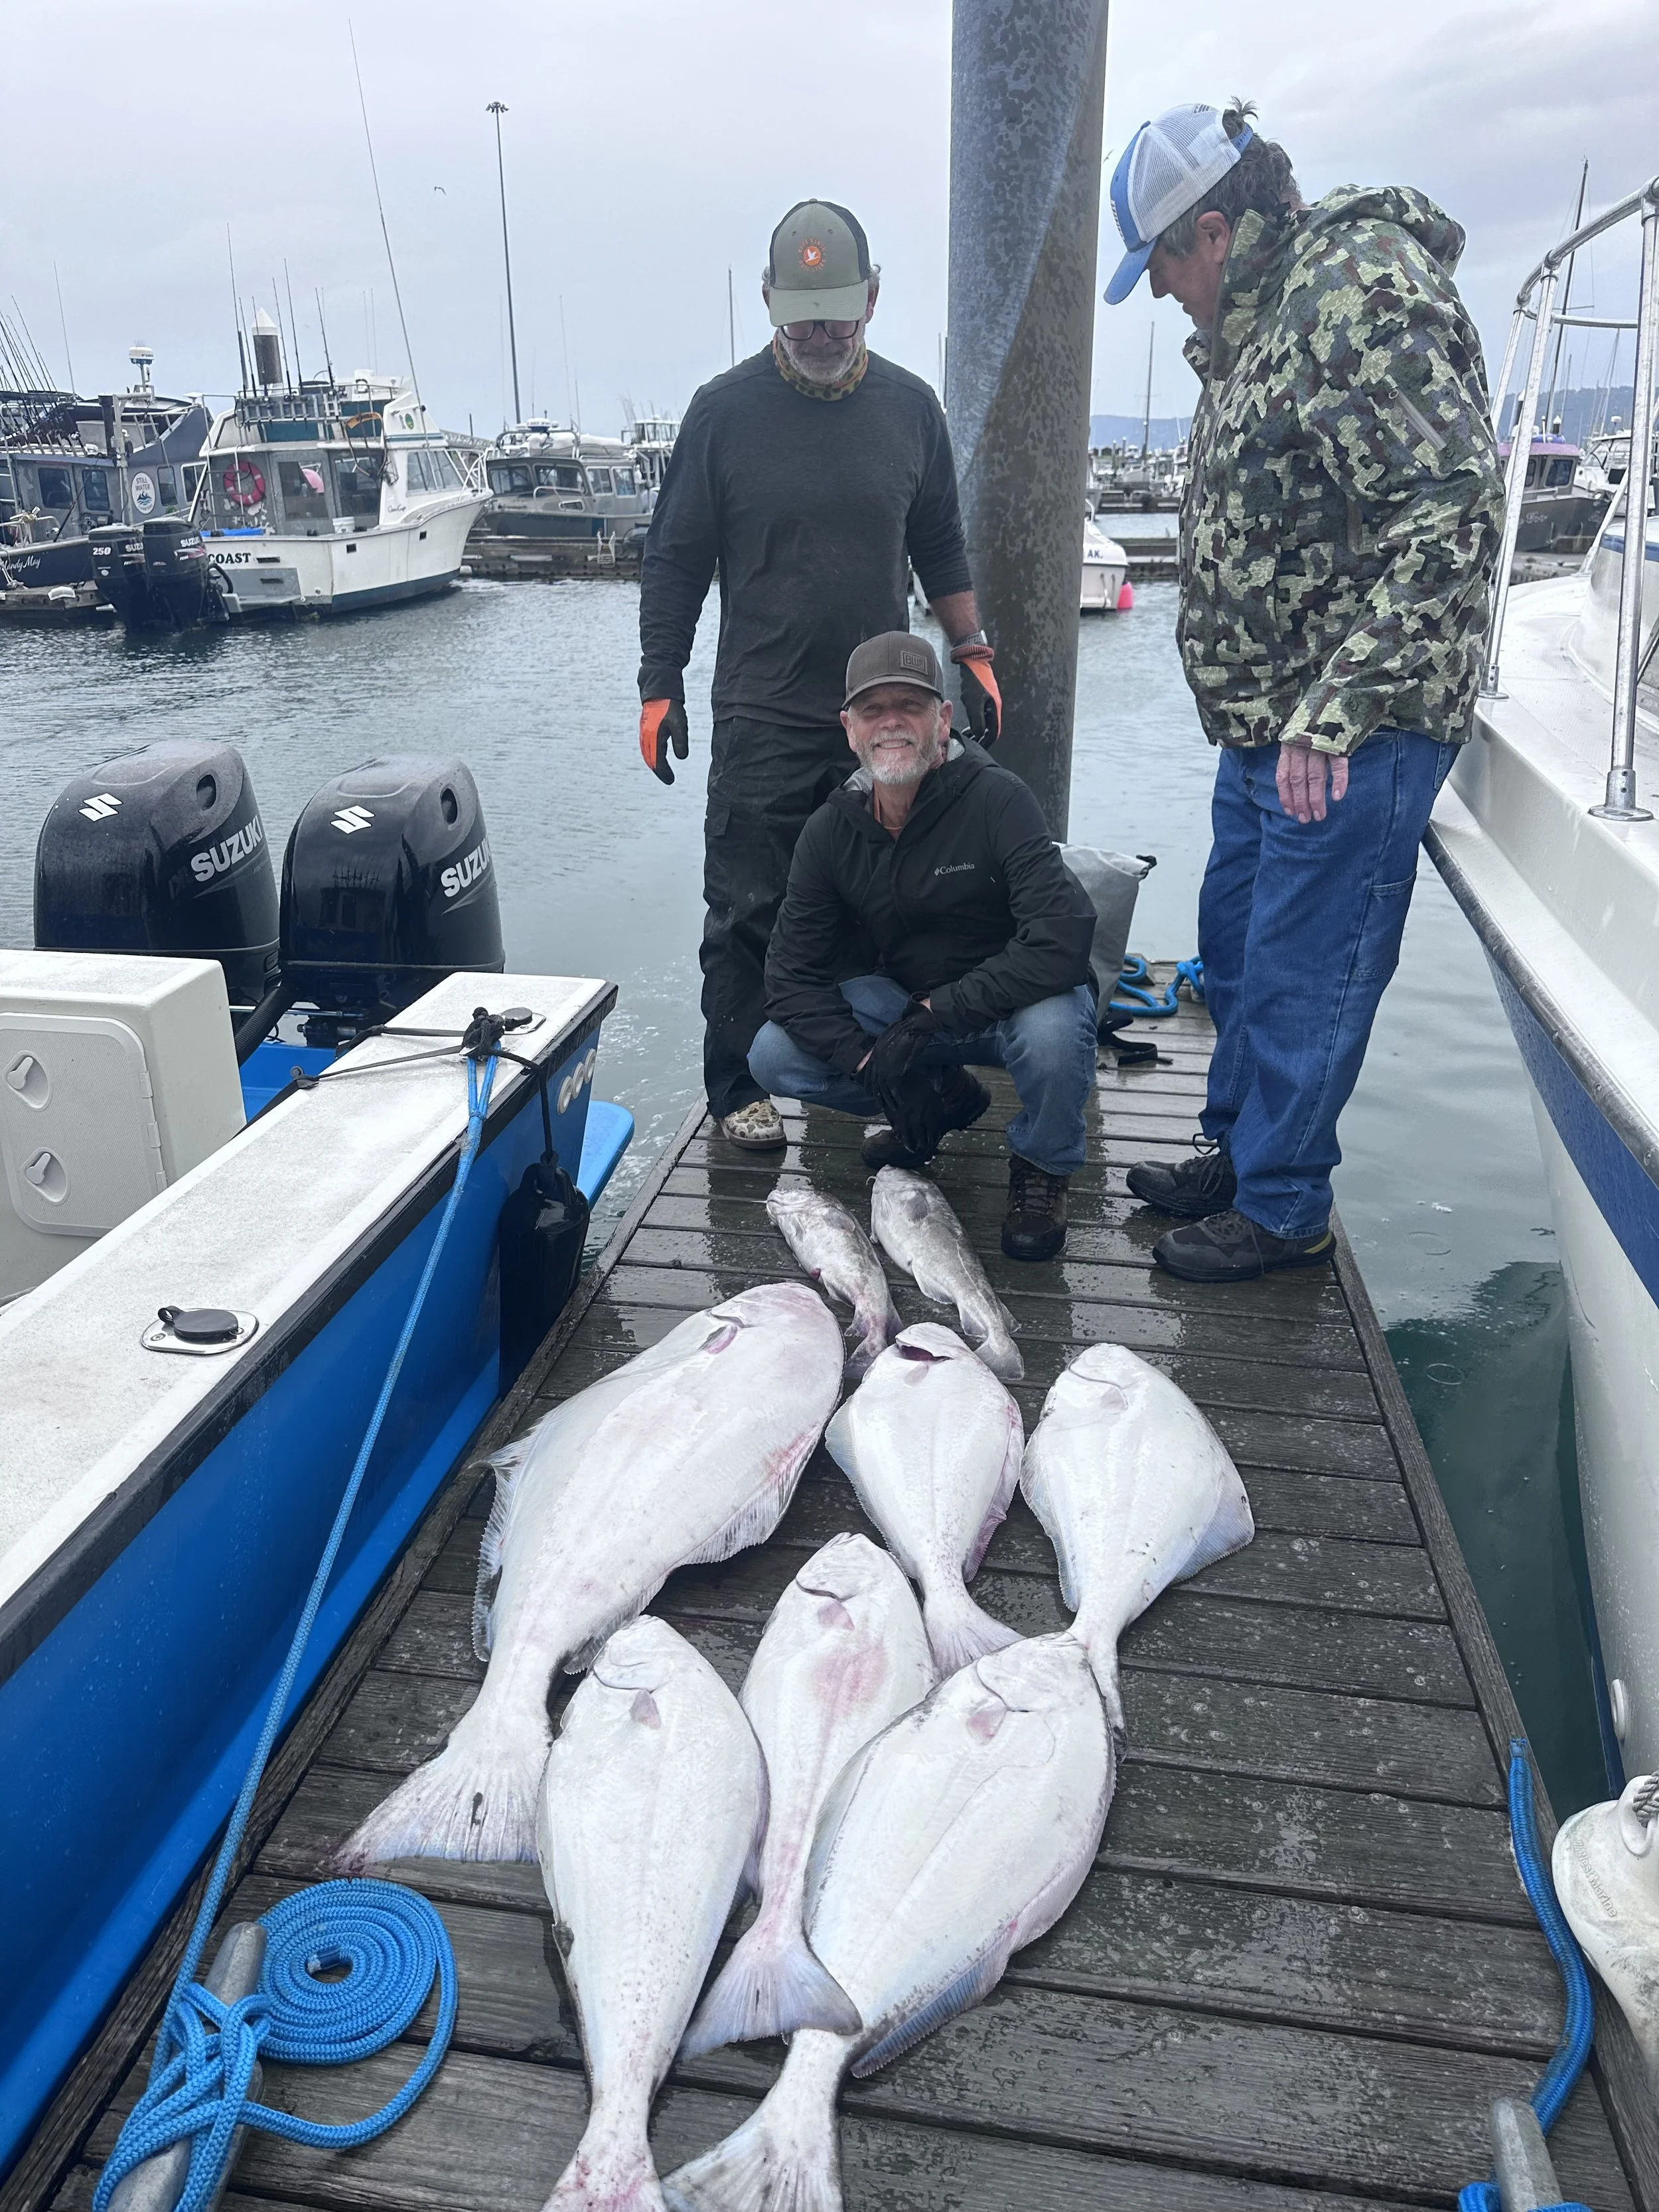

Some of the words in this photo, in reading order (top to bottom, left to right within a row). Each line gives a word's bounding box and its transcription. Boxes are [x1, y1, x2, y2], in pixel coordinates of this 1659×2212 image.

[93, 547, 111, 555] 250
[208, 552, 252, 564] COAST
[23, 555, 41, 569] May
[190, 814, 263, 882] SUZUKI
[441, 836, 492, 897] SUZUK
[940, 862, 975, 874] Columbia
[1578, 1850, 1594, 1878] West
[1588, 1874, 1618, 1918] Marine
